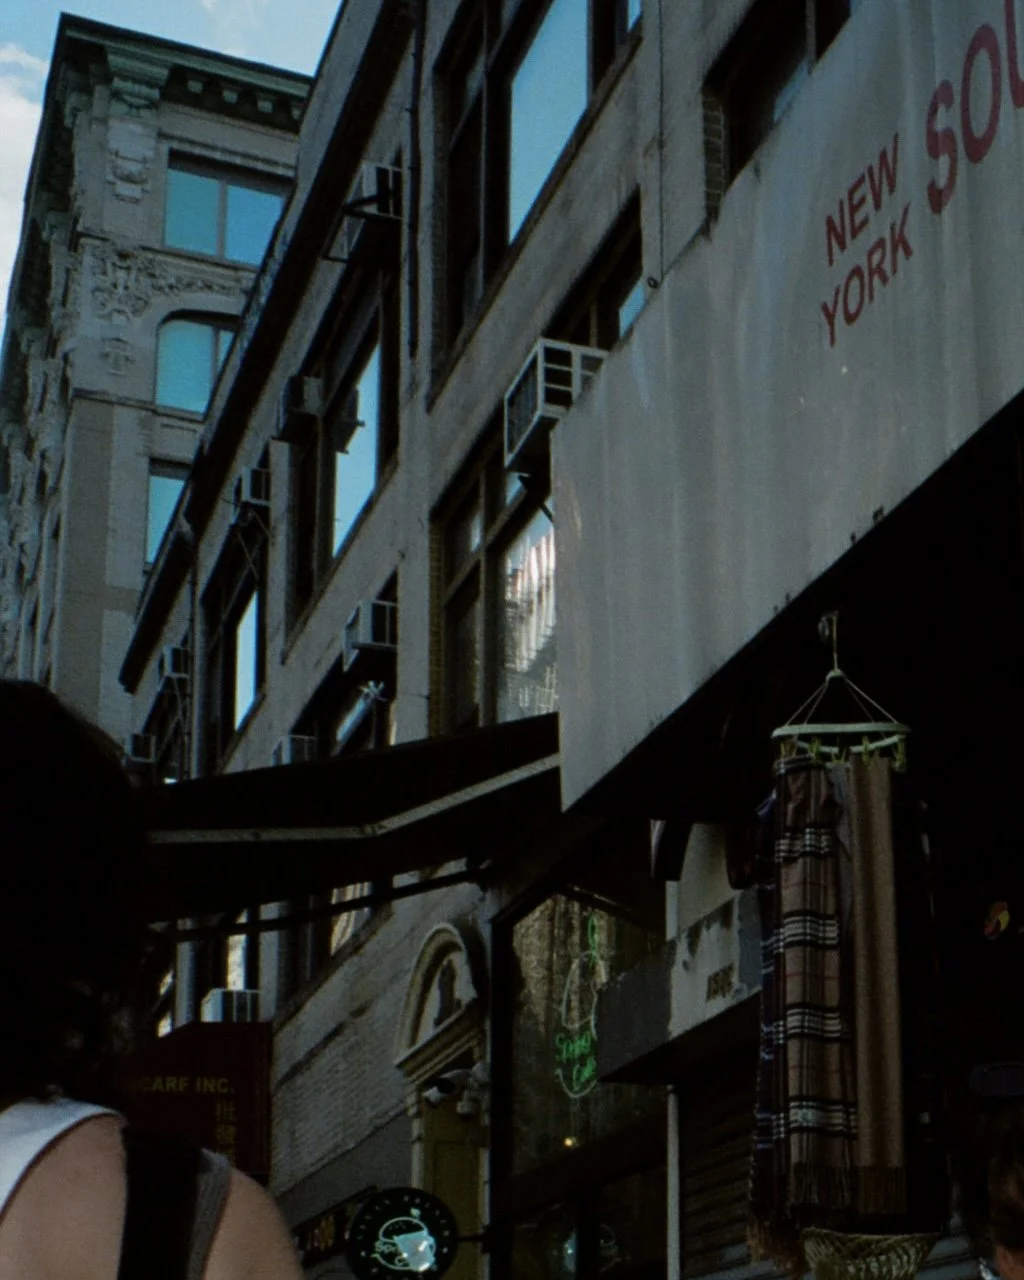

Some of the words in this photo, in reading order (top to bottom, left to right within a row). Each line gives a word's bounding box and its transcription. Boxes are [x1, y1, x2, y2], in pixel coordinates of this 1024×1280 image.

[826, 131, 899, 267] NEW
[821, 202, 913, 348] YORK
[195, 1076, 236, 1095] INC.
